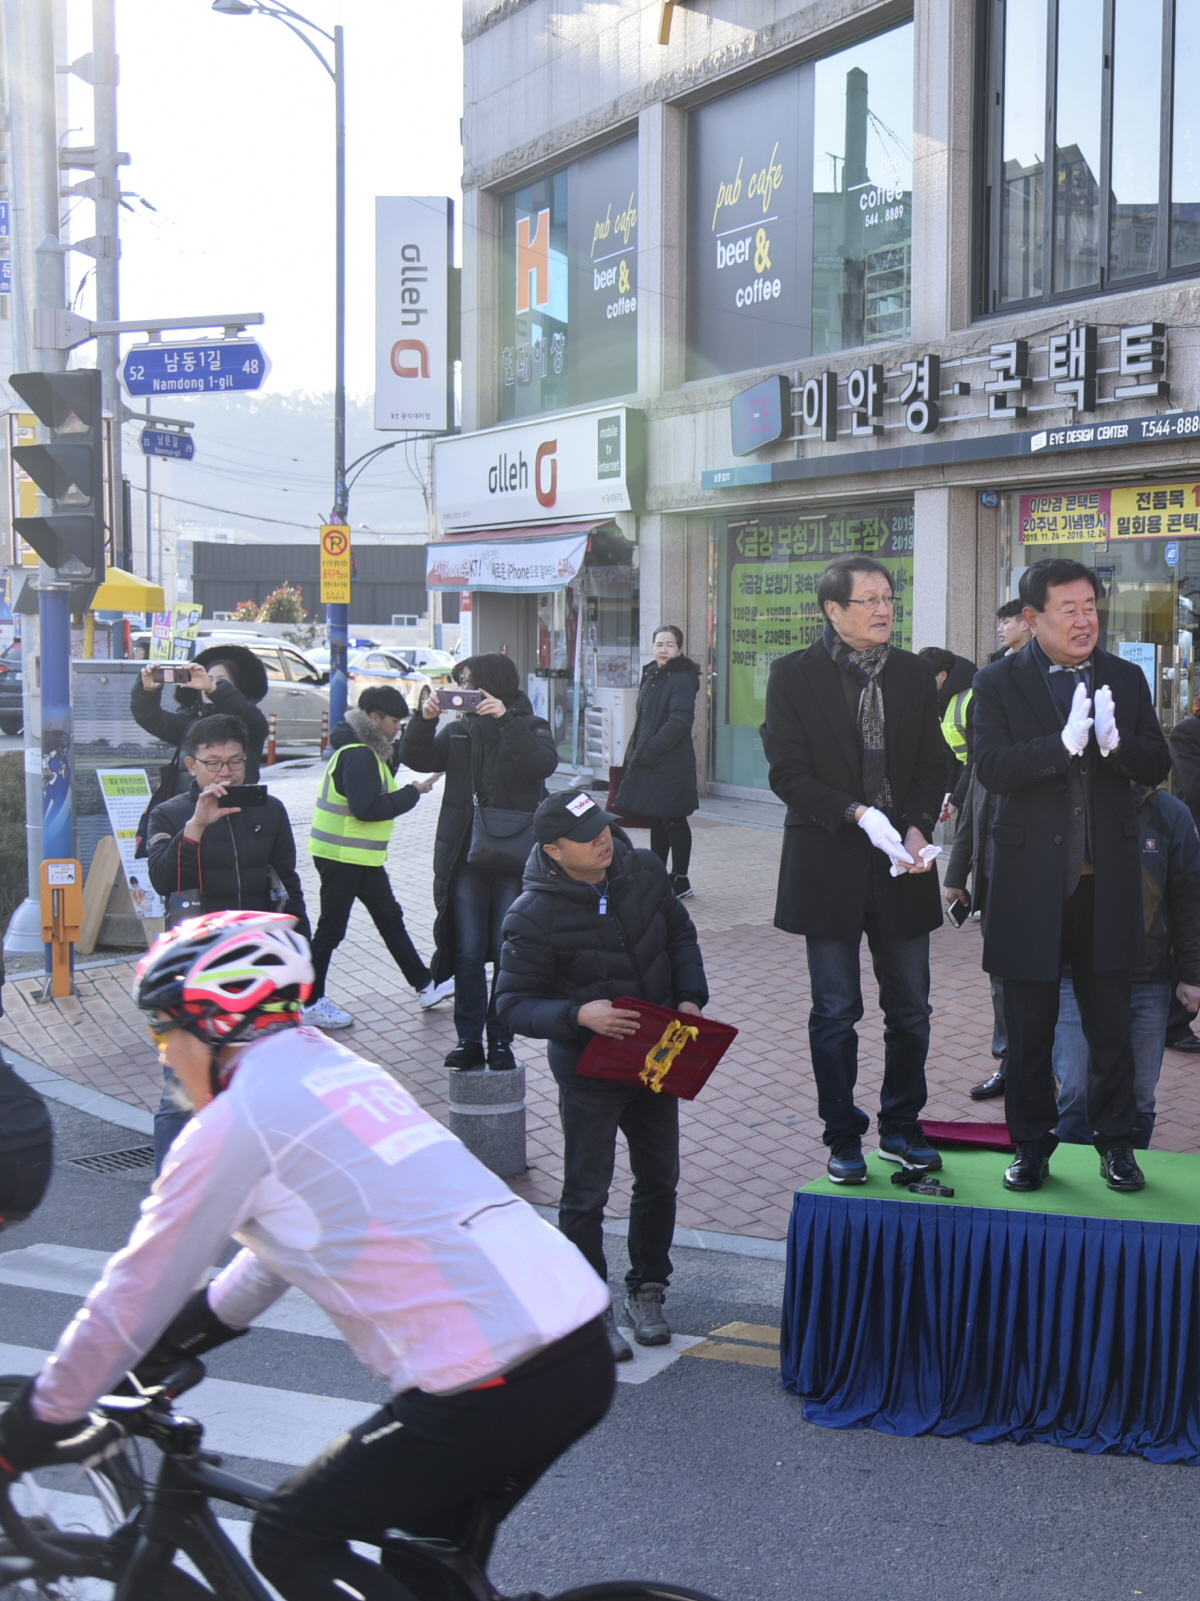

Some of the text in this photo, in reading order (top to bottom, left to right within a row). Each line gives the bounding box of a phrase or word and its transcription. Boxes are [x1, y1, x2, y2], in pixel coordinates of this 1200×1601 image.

[712, 141, 784, 231] pub cafe
[859, 183, 904, 211] coffee
[591, 191, 638, 258] pub cafe
[716, 227, 772, 273] beer &
[594, 260, 630, 293] beer &
[735, 278, 782, 307] coffee
[607, 296, 637, 319] coffee
[164, 350, 221, 373] 남동1길
[242, 359, 259, 374] 48
[502, 331, 566, 387] 현대해상
[129, 365, 145, 381] 52
[153, 375, 234, 391] Namdong 1-gil
[600, 425, 619, 439] mobile
[1049, 424, 1129, 446] EYE DESIGN CENTER
[606, 444, 613, 456] tv
[598, 459, 620, 474] internet
[1029, 492, 1100, 514] 이안경 콘택트
[1135, 489, 1185, 511] 전품목
[1023, 511, 1108, 533] 20주년 기념행사
[1117, 514, 1163, 536] 일회용
[778, 522, 824, 555] 보청기
[746, 573, 763, 595] 금강
[765, 573, 792, 595] 보청기
